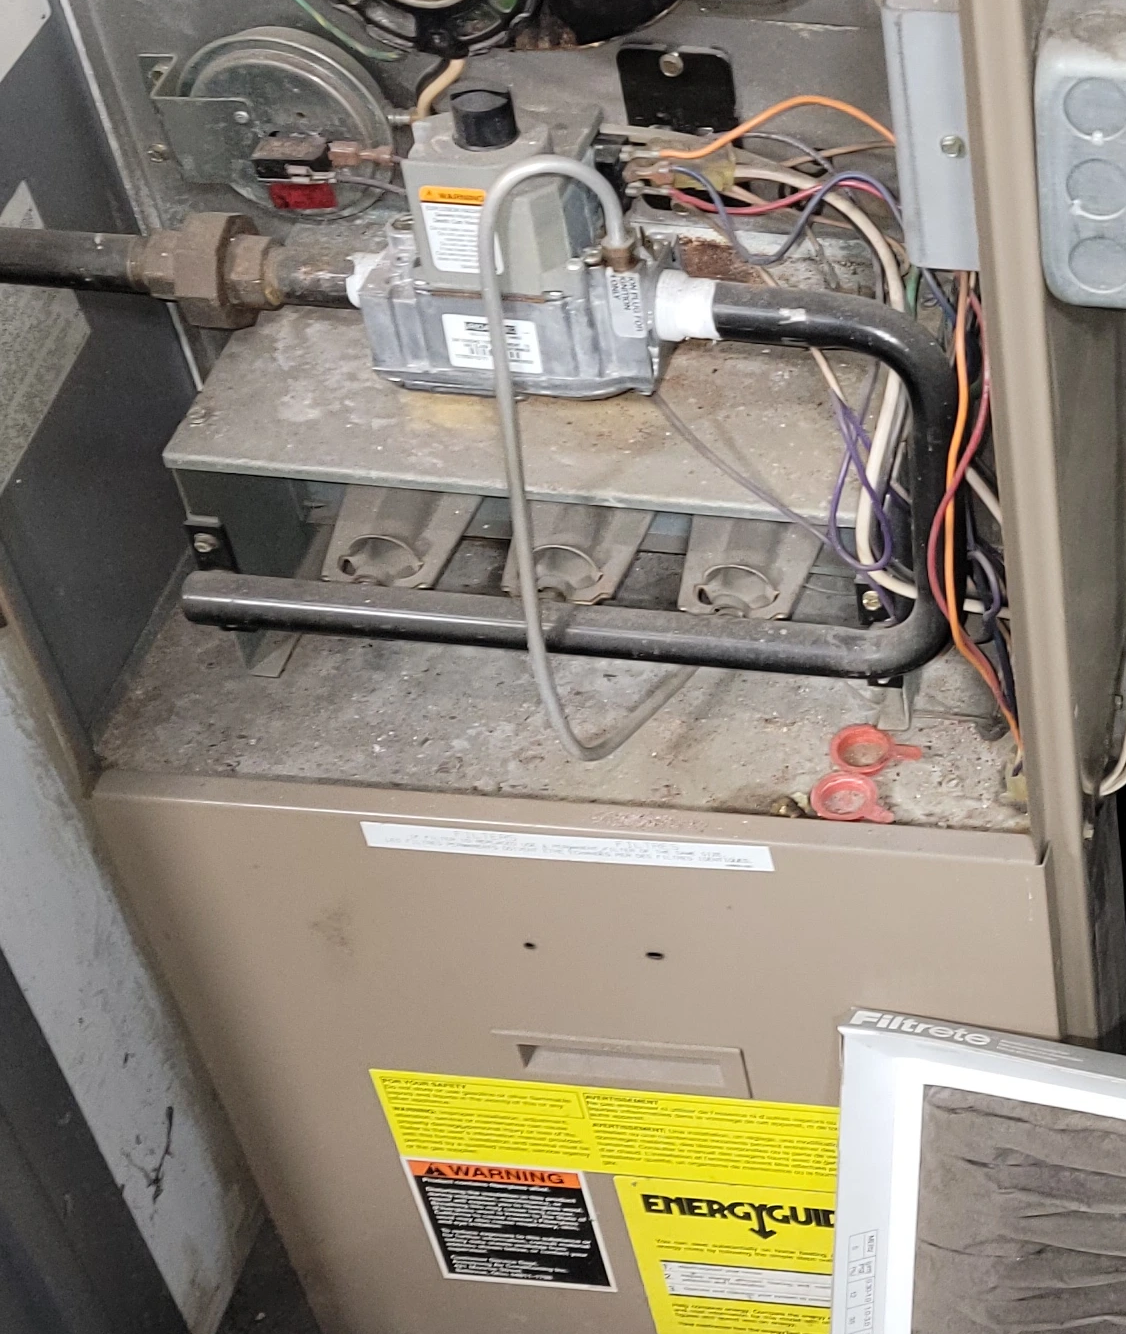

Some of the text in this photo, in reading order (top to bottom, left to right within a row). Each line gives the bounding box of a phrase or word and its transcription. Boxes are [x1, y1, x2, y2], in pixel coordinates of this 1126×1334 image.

[849, 1010, 991, 1046] Filtrete
[449, 1165, 565, 1185] WARNING
[640, 1193, 835, 1239] ENERGYGUID
